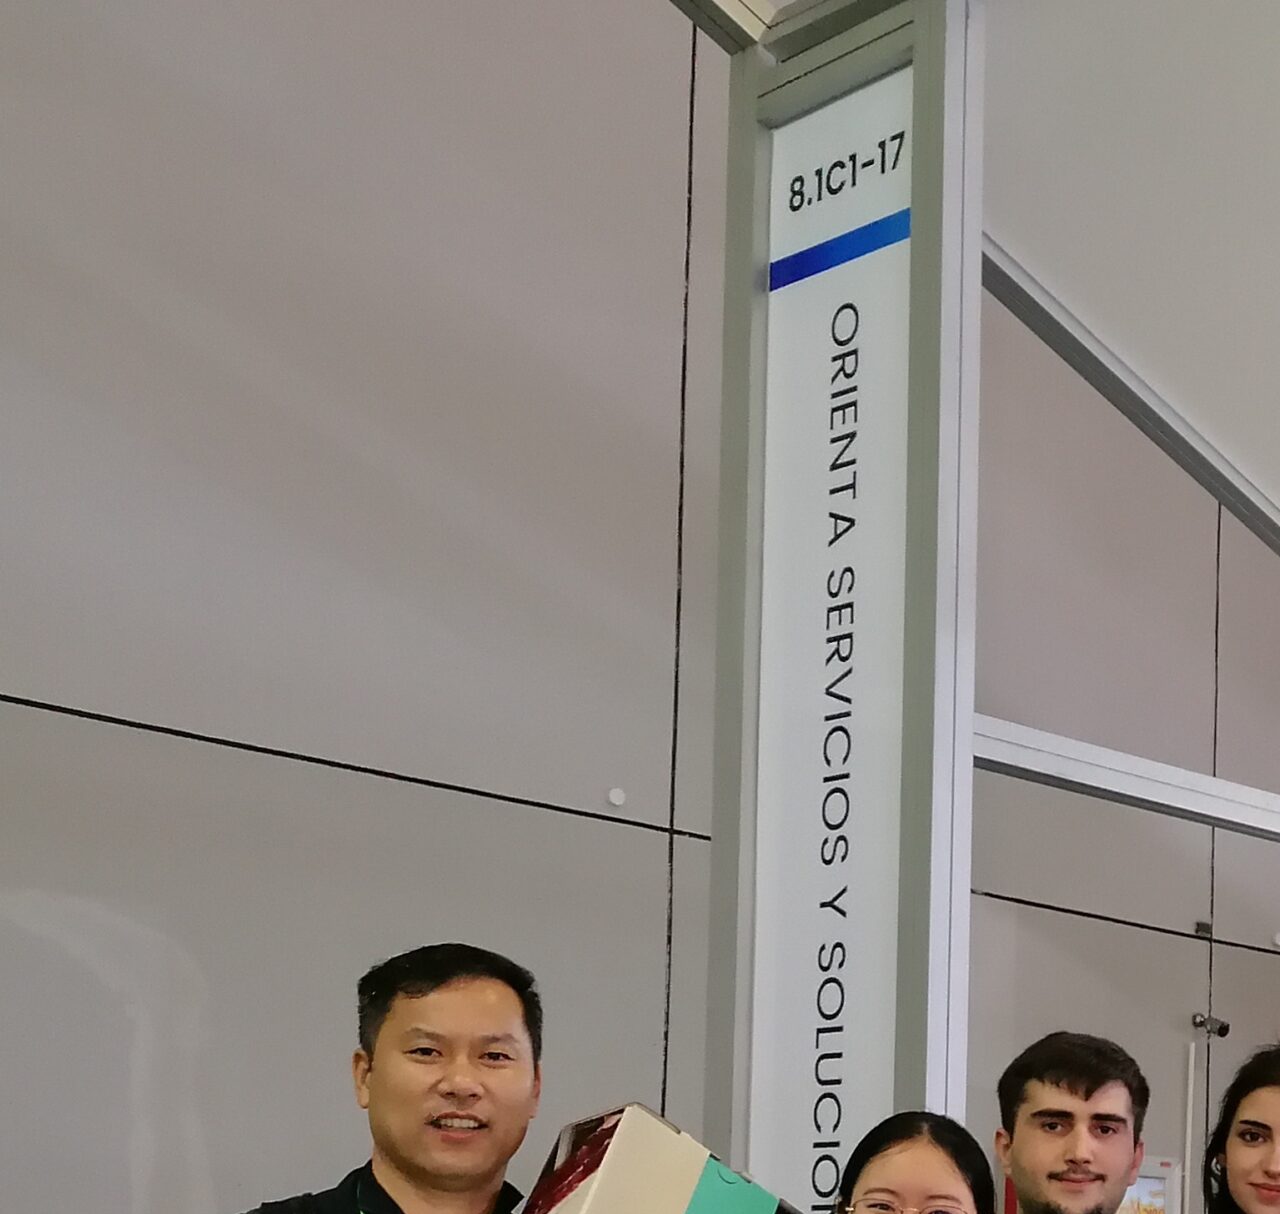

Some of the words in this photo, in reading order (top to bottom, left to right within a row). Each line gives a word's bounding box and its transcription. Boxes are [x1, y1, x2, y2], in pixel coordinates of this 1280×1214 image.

[789, 131, 906, 212] 8.1C1-17
[818, 566, 856, 866] SERVICIOS
[818, 886, 848, 918] Y
